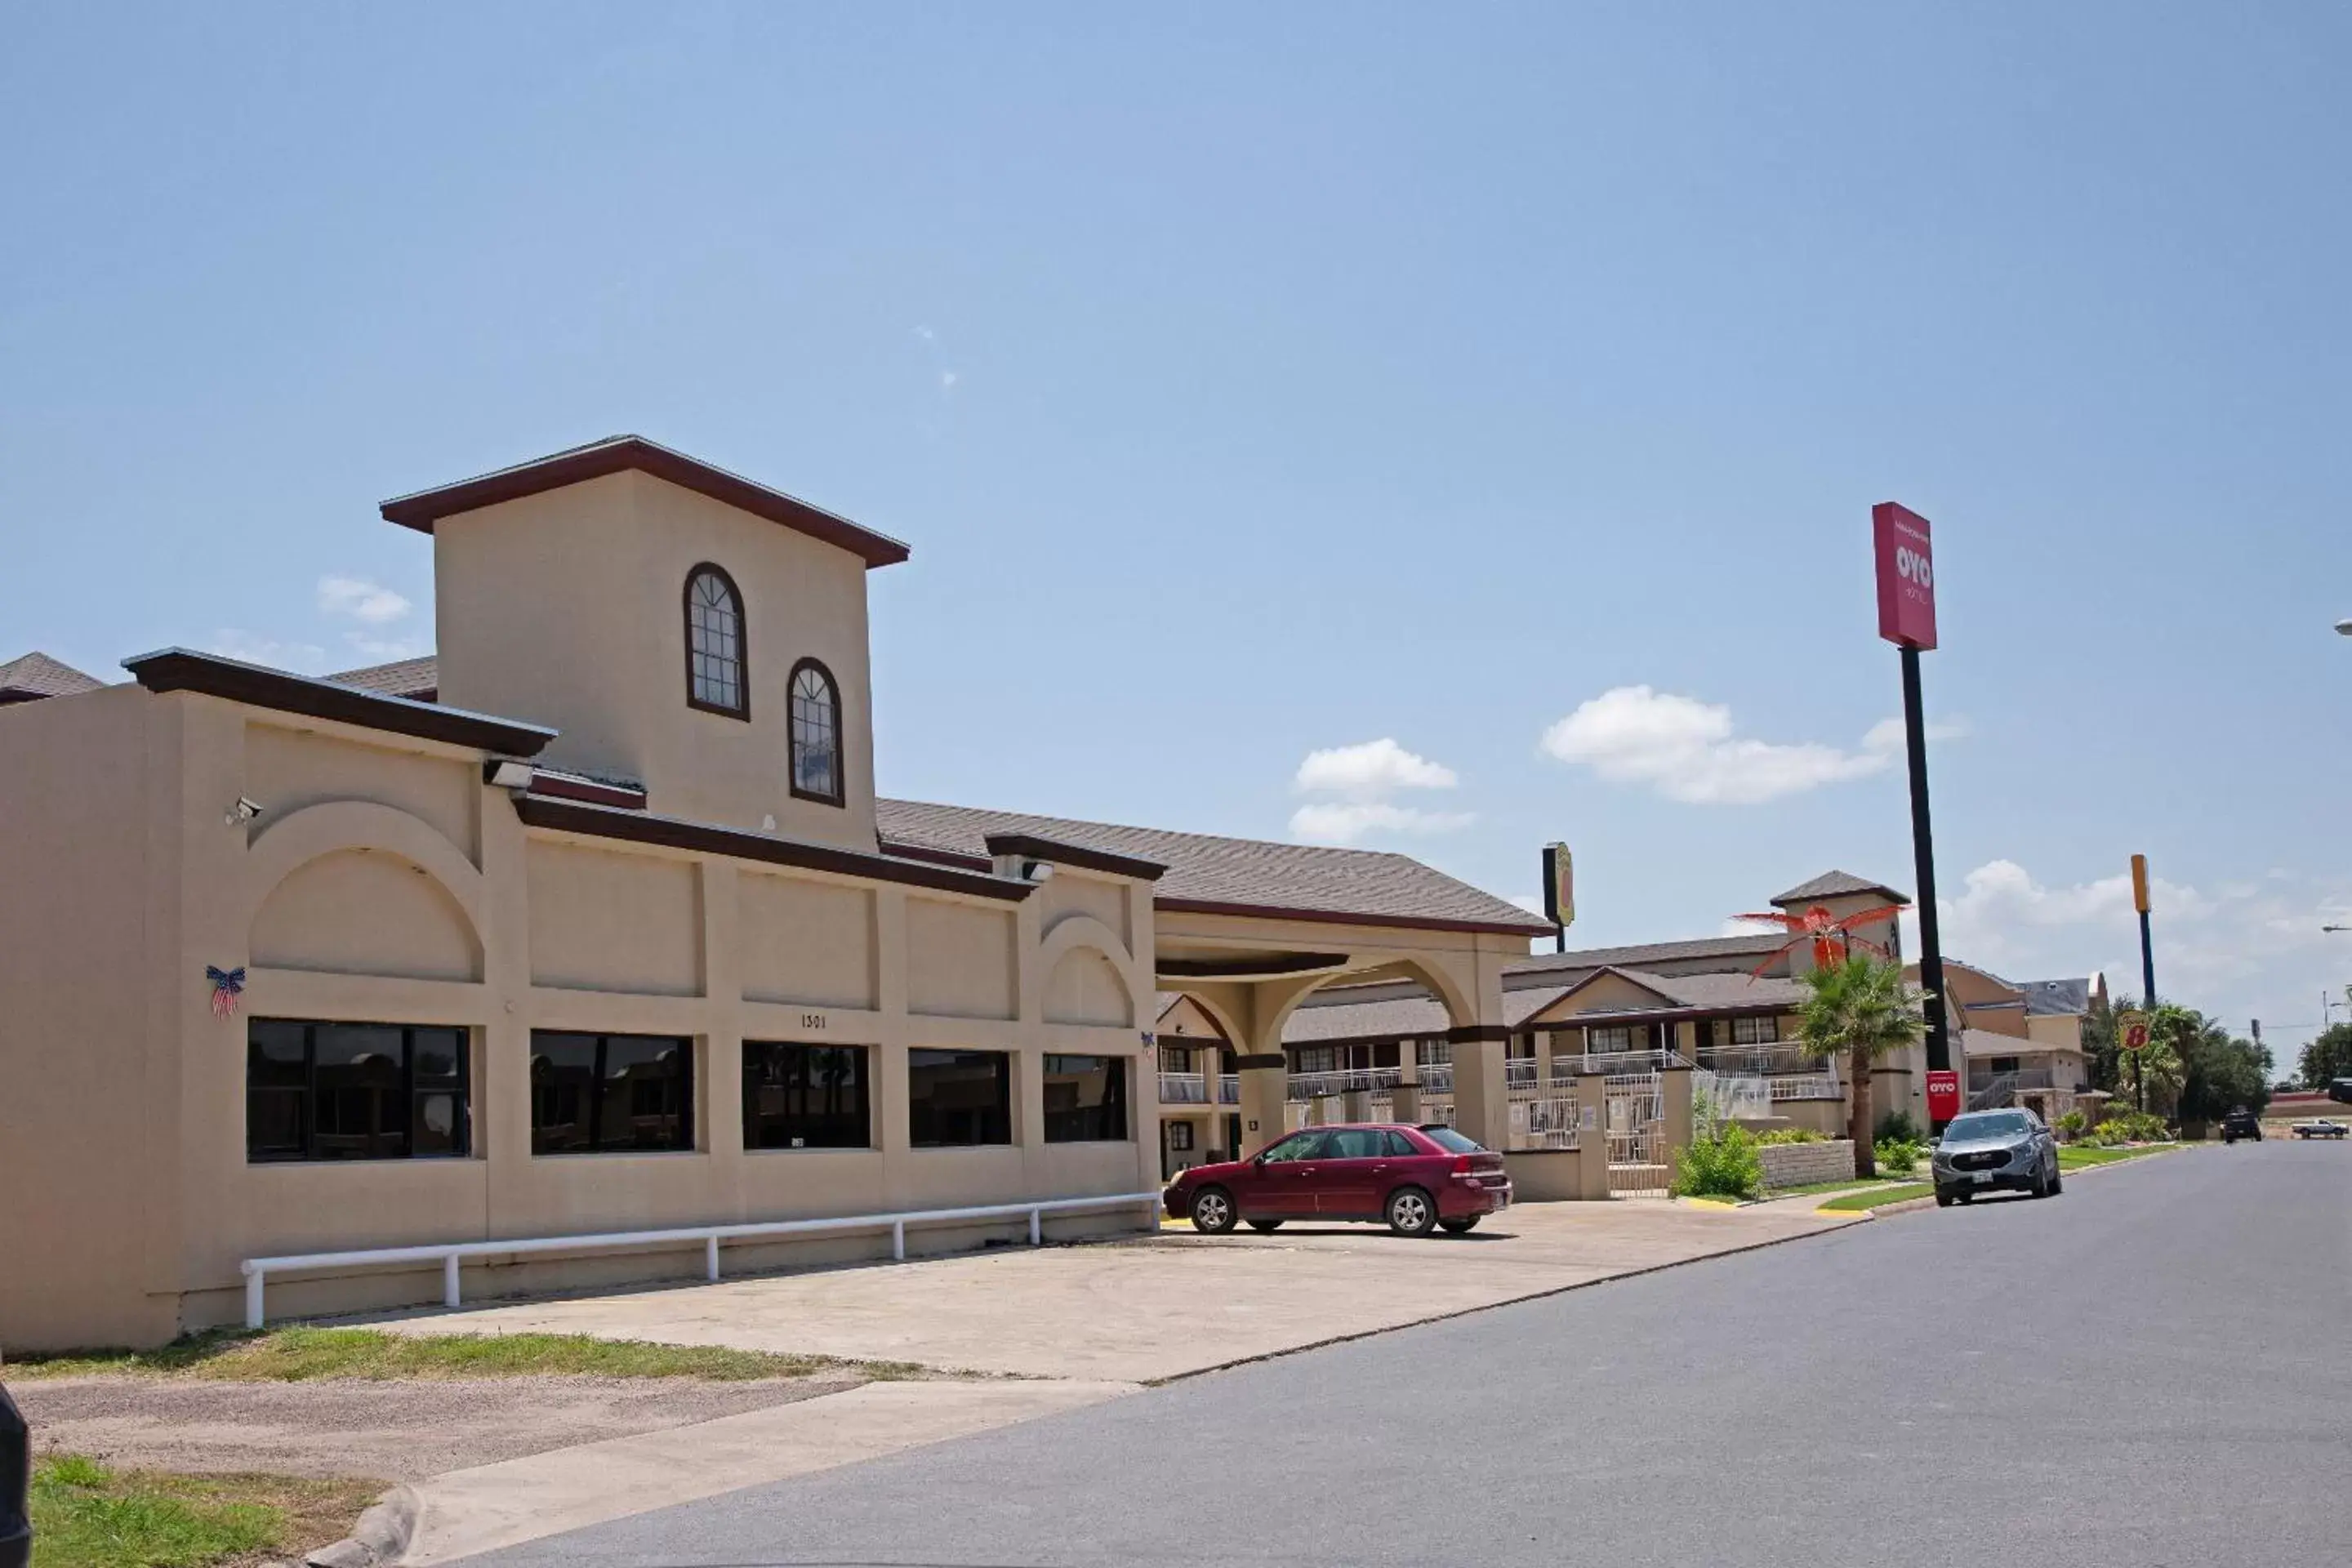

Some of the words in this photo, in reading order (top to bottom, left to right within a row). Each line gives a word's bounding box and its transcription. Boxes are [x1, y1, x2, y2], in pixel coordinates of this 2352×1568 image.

[1896, 546, 1931, 588] OYO
[802, 1013, 826, 1029] 1301
[2126, 1025, 2146, 1048] 8
[1929, 1083, 1956, 1093] OYO
